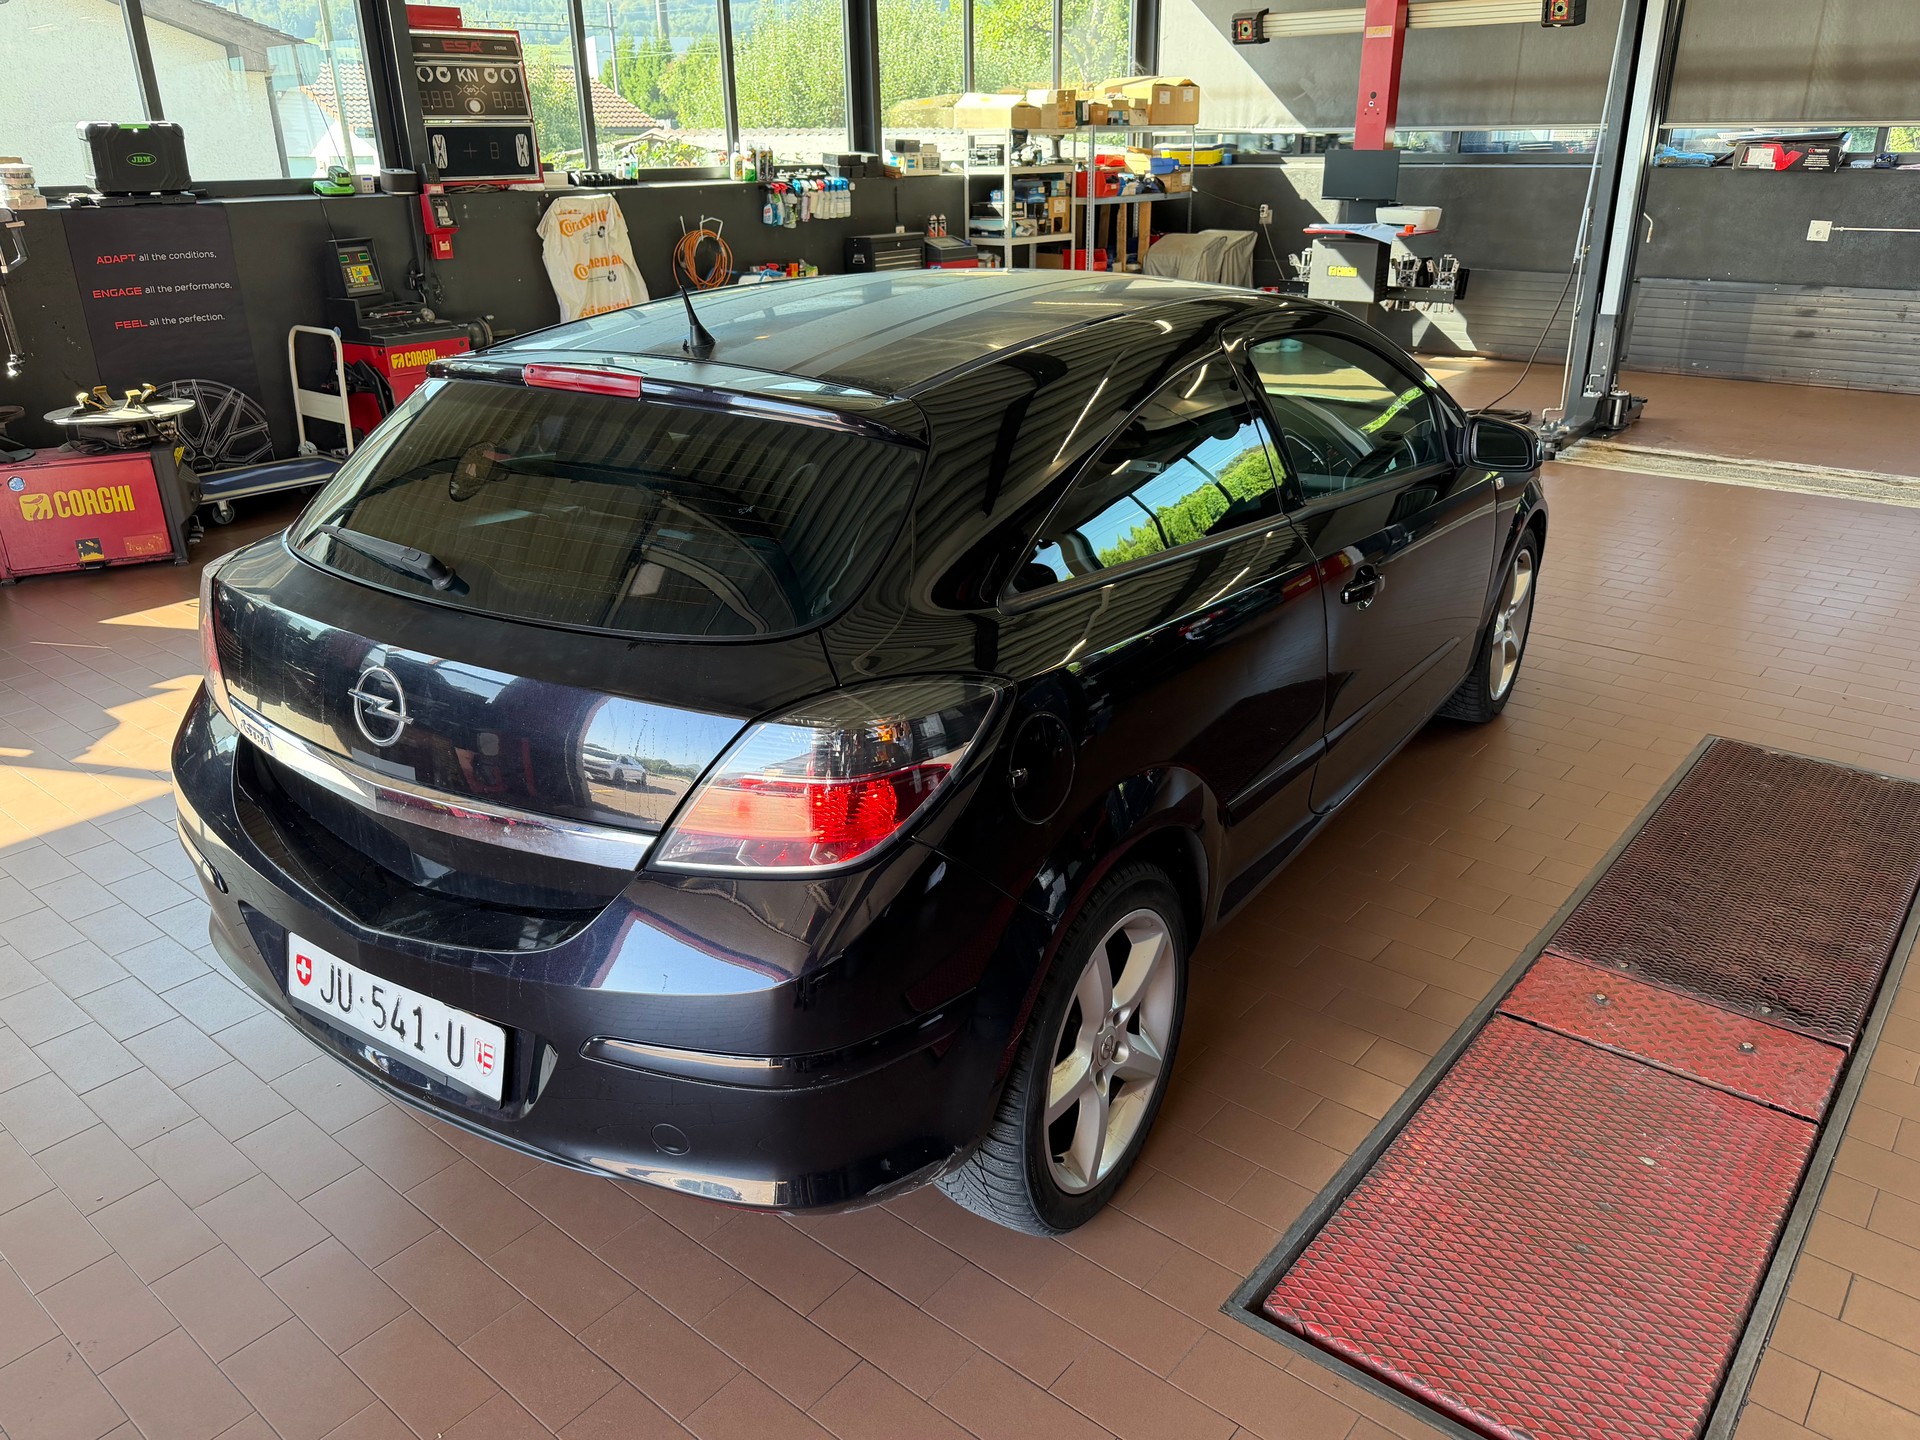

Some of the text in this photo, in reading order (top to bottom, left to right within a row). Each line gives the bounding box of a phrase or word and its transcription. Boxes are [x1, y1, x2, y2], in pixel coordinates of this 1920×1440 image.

[441, 39, 484, 53] ESA
[456, 68, 479, 82] KN
[96, 254, 136, 264] ADAPT
[138, 253, 149, 262] all
[151, 252, 167, 261] the
[92, 286, 143, 299] ENGAGE
[144, 285, 156, 294] all
[157, 284, 173, 293] the
[114, 319, 148, 330] FEEL
[149, 317, 160, 326] all
[161, 316, 177, 325] the
[404, 348, 437, 368] CORGHI
[53, 485, 135, 518] CORGHI
